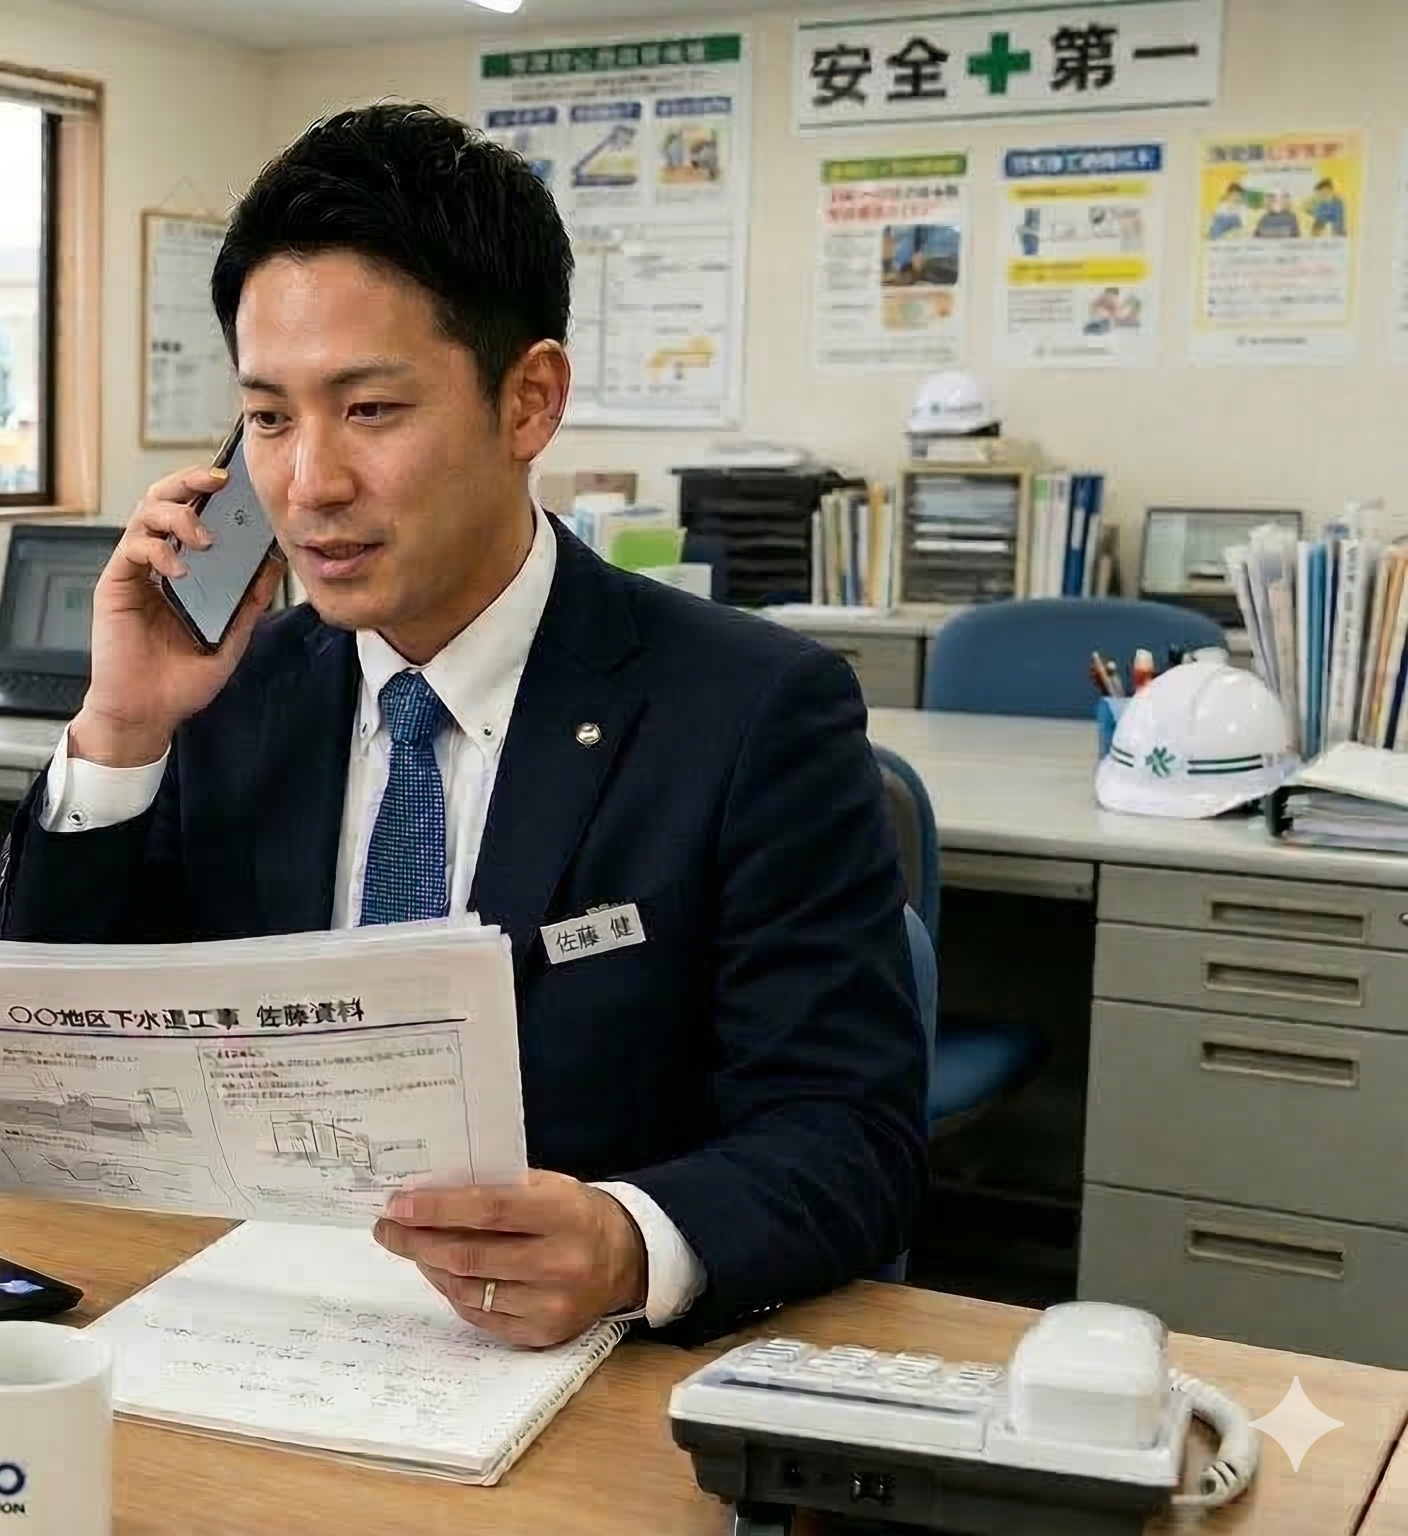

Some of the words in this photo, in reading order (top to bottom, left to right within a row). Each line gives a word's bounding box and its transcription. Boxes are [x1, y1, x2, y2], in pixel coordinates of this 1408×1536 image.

[811, 37, 950, 108] 安全
[1050, 22, 1200, 93] 第一
[555, 925, 600, 955] 佐藤
[609, 915, 635, 941] 健
